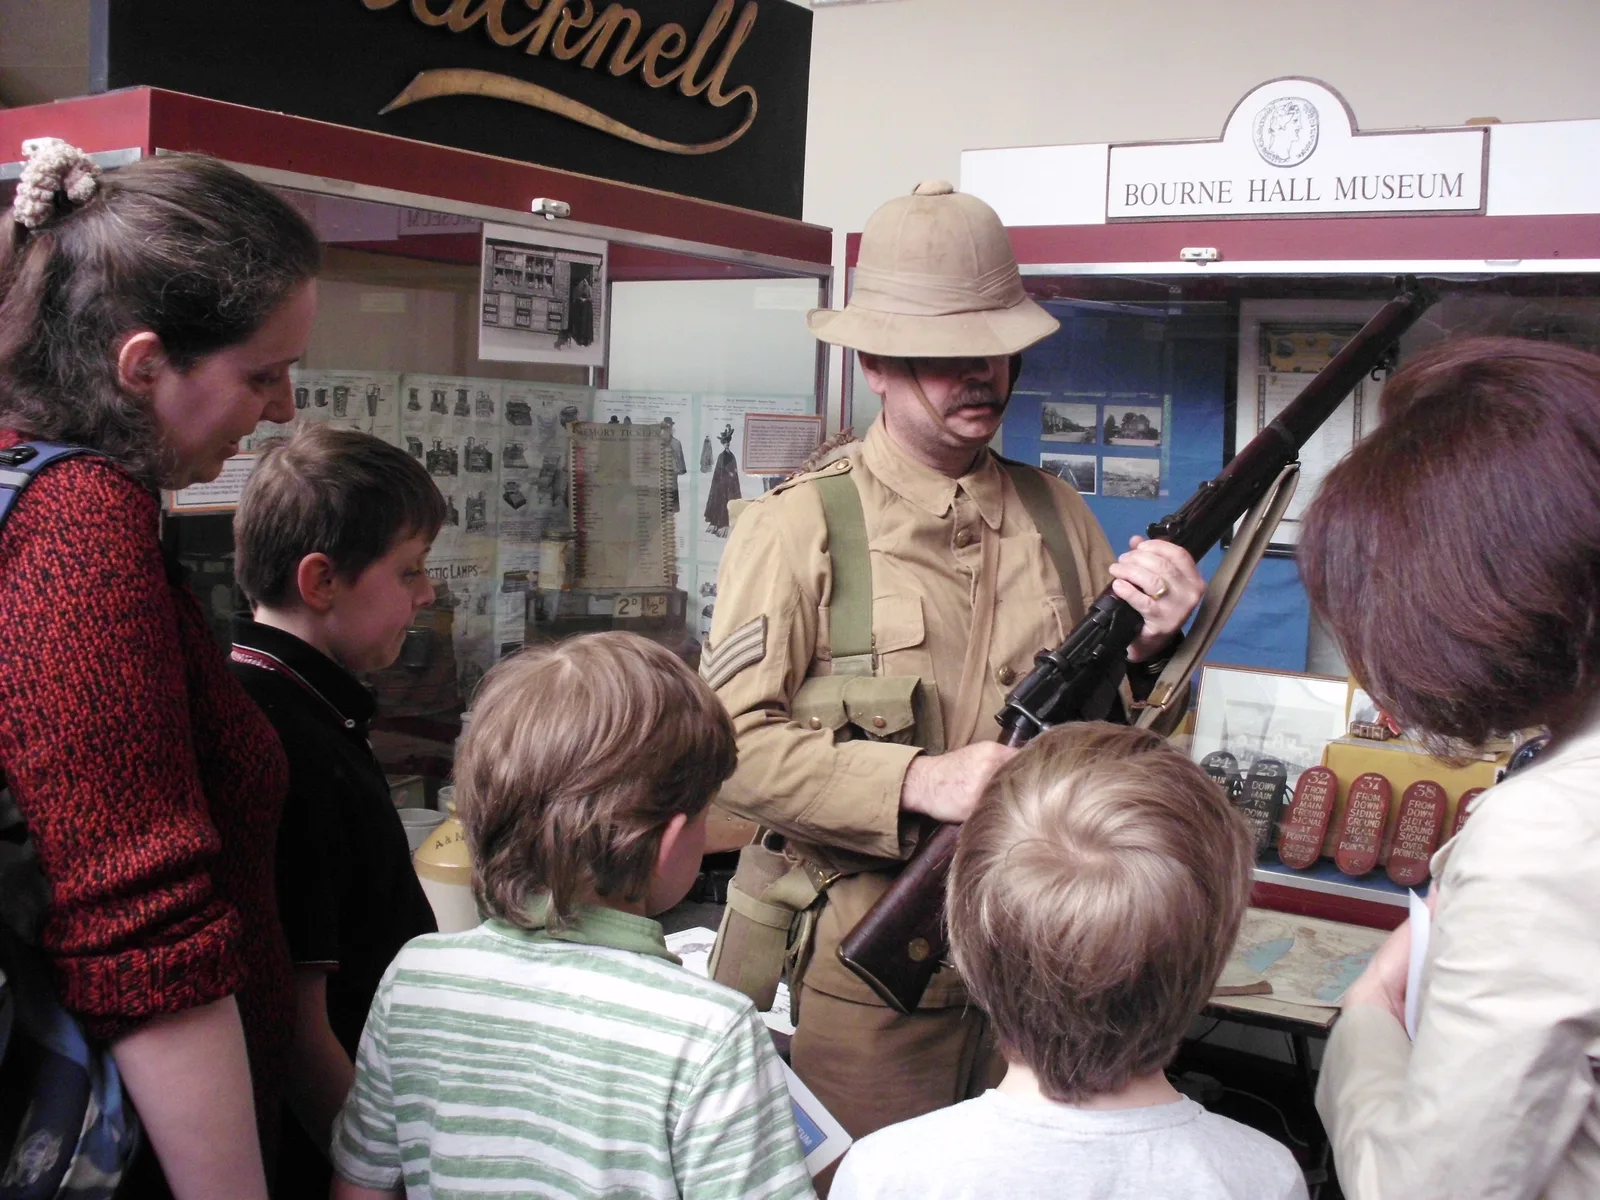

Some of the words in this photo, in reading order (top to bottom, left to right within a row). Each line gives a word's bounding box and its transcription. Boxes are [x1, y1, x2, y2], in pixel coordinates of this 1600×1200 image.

[1125, 180, 1233, 206] BOURNE
[1248, 178, 1321, 202] HALL
[1335, 172, 1465, 200] MUSEUM
[1256, 763, 1278, 777] 25
[1307, 771, 1331, 786] 32
[1251, 780, 1276, 792] DOWN
[1303, 784, 1328, 795] FROM
[1413, 784, 1437, 799] 38
[1251, 791, 1273, 801] MAIN
[1301, 793, 1325, 803] DOWN
[1355, 791, 1380, 802] FROM
[1299, 801, 1322, 811] MAIN
[1353, 800, 1380, 811] DOWN
[1408, 799, 1436, 811] FROM
[1243, 807, 1270, 819] DOWN
[1292, 807, 1326, 819] GROUND
[1349, 808, 1382, 820] SIDING
[1406, 808, 1434, 818] DOWN
[1291, 816, 1323, 827] SIGNAL
[1347, 816, 1381, 829] GROUND
[1401, 816, 1436, 829] SIDING
[1298, 825, 1312, 834] AT
[1344, 825, 1377, 837] SIGNAL
[1399, 824, 1434, 837] GROUND
[1398, 832, 1430, 845] SIGNAL
[1401, 841, 1424, 852] OVER
